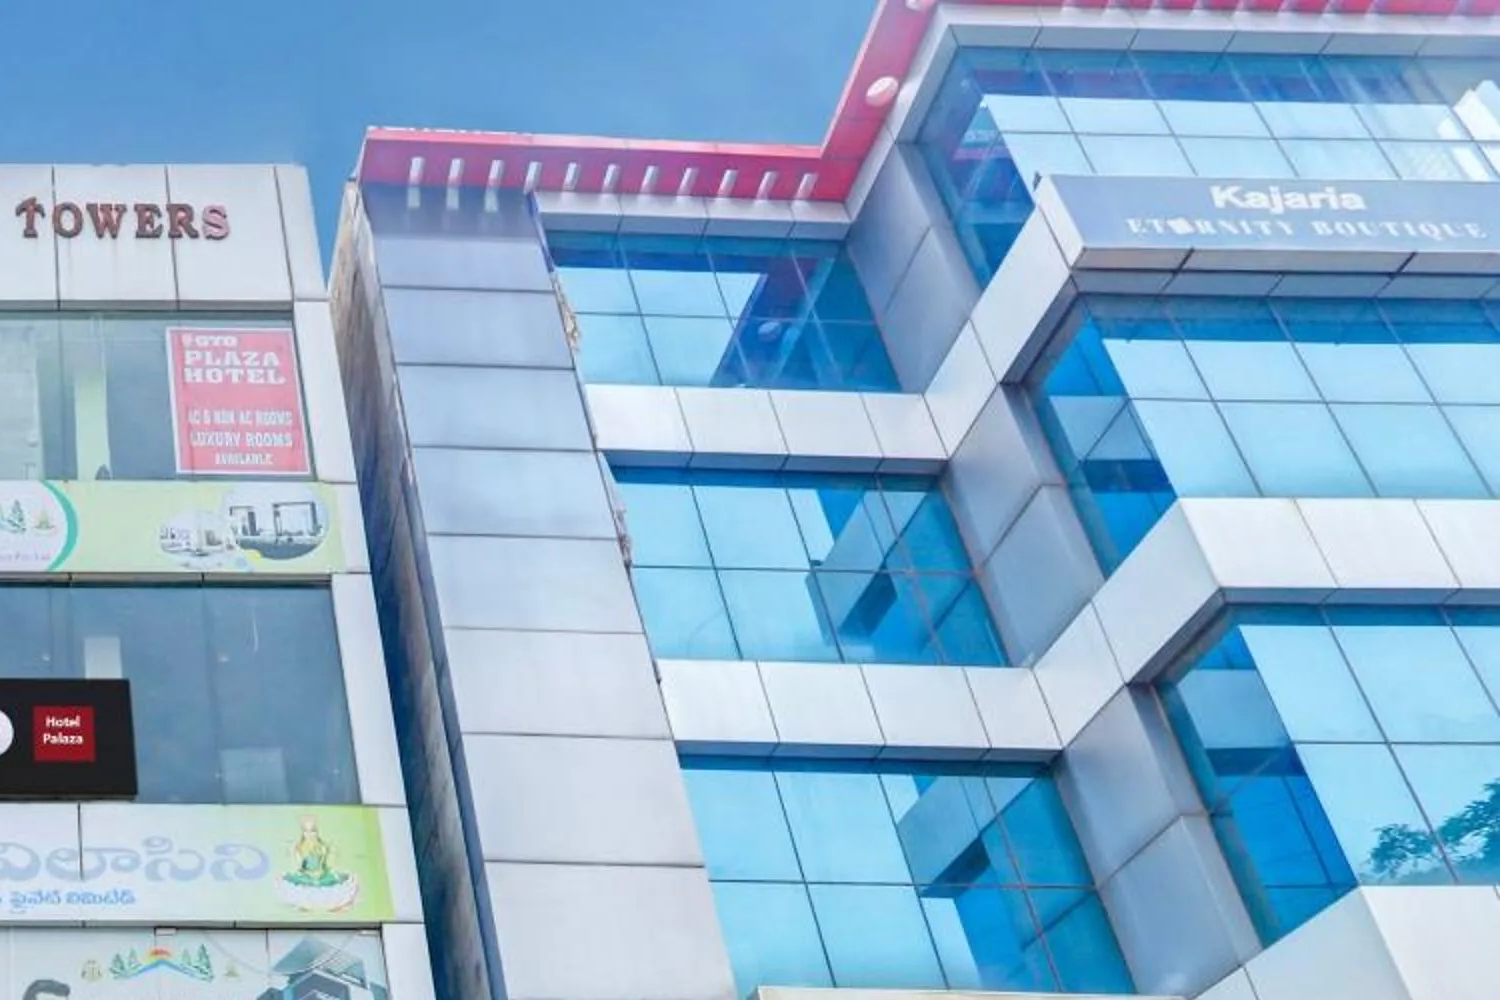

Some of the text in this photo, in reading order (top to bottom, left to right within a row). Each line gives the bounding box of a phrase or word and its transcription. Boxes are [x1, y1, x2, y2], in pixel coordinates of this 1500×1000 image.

[1210, 185, 1367, 214] Kajaria
[15, 196, 231, 240] TOWERS
[1311, 220, 1489, 241] BOUTIQUE
[184, 350, 280, 367] PLAZA
[183, 367, 287, 384] HOTEL
[190, 431, 293, 448] LUXURY ROOMS
[46, 715, 81, 728] Hotel
[43, 733, 84, 745] Palaza
